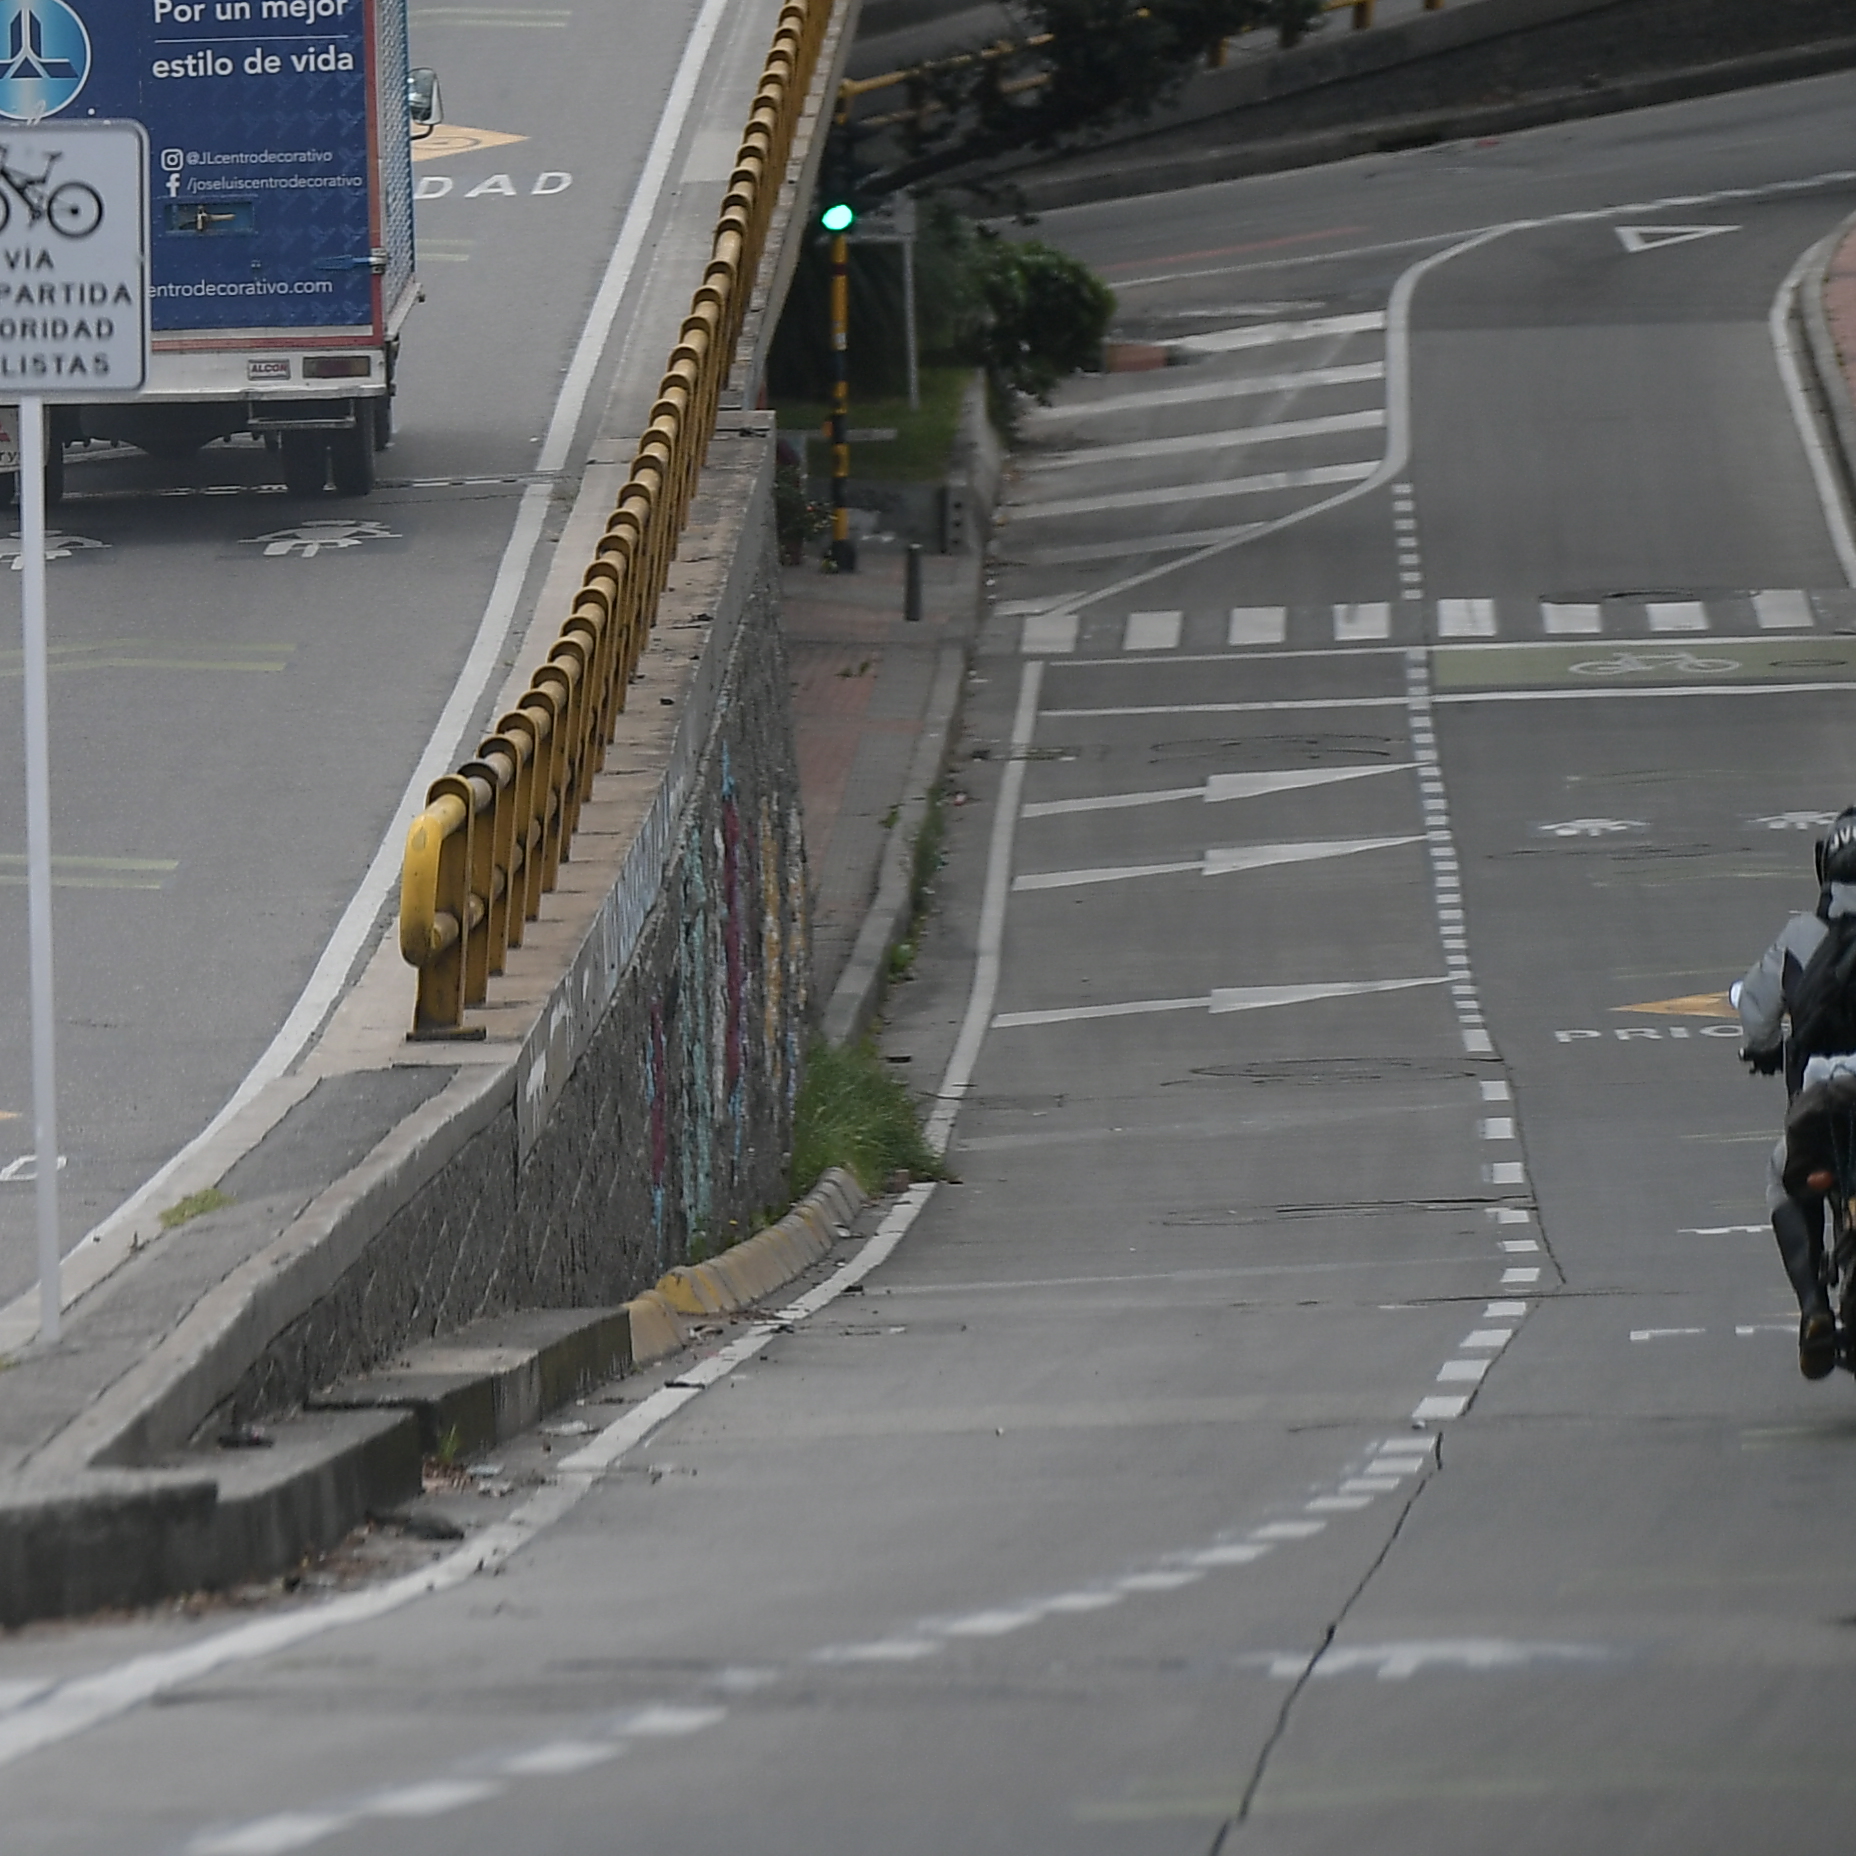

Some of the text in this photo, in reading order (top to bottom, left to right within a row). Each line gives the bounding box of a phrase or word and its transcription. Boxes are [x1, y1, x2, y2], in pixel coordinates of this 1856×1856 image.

[215, 0, 251, 21] un
[151, 44, 354, 79] estilo de vida
[186, 148, 333, 166] @JLcentrodecorativo
[148, 278, 333, 298] entrodecorativo.com
[251, 364, 287, 373] ALCON
[1553, 1024, 1745, 1043] PRIO
